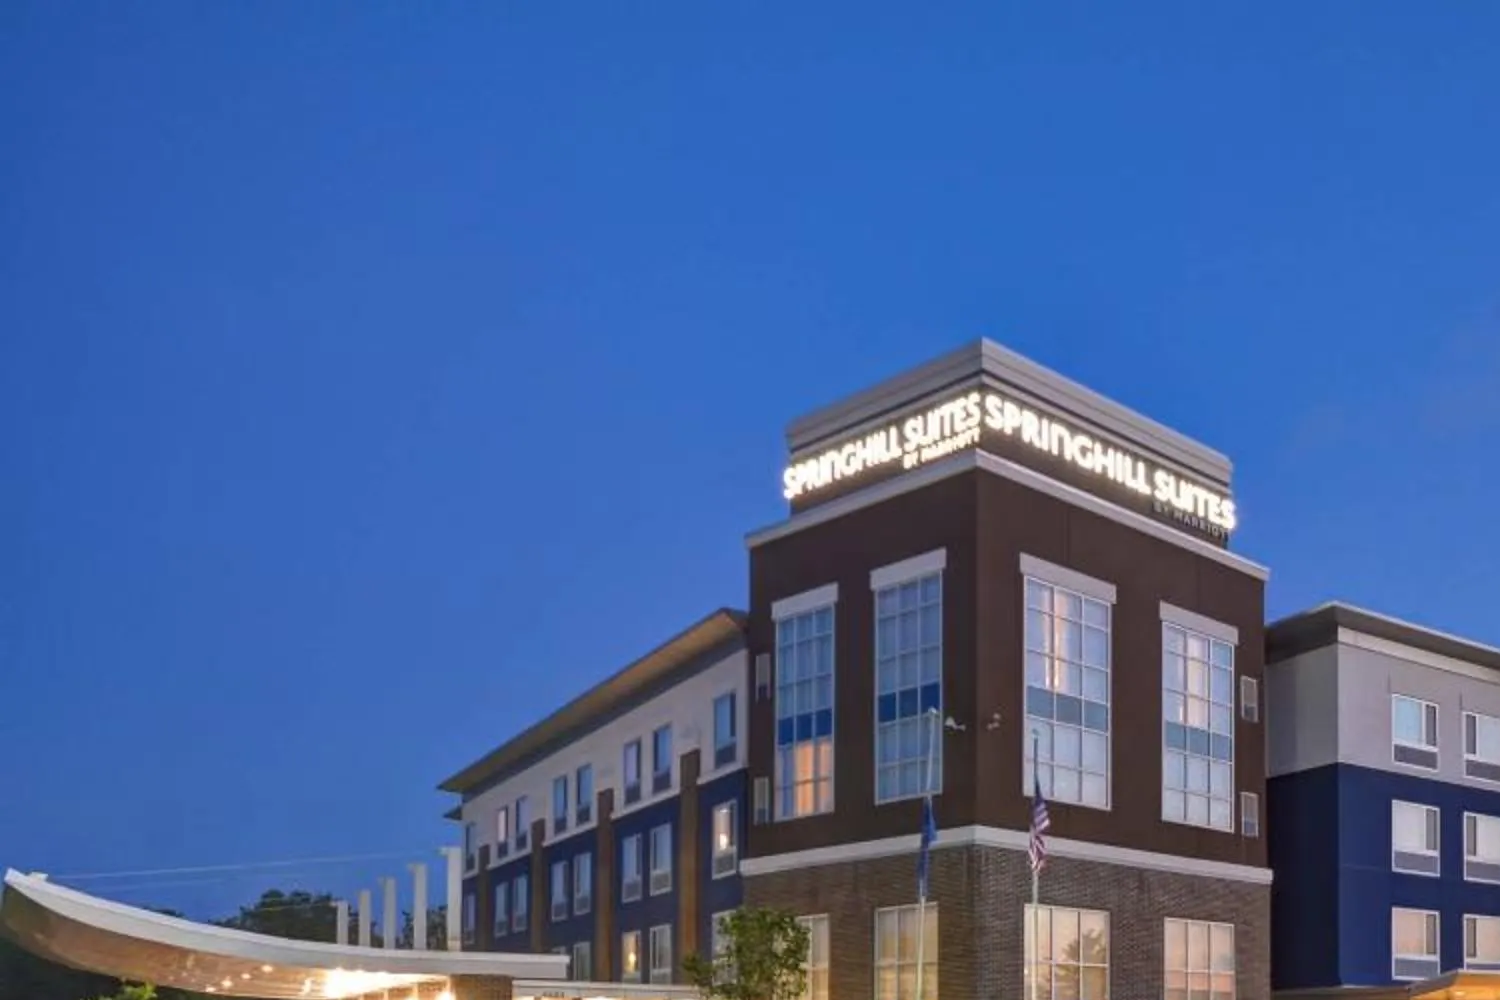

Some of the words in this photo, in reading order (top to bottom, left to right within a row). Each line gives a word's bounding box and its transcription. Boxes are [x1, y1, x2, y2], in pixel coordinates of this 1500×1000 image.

[783, 427, 903, 499] SPRINGHILL
[903, 392, 981, 452] SUITES
[985, 394, 1152, 495] SPRINGHILL
[1153, 469, 1236, 529] SUITES
